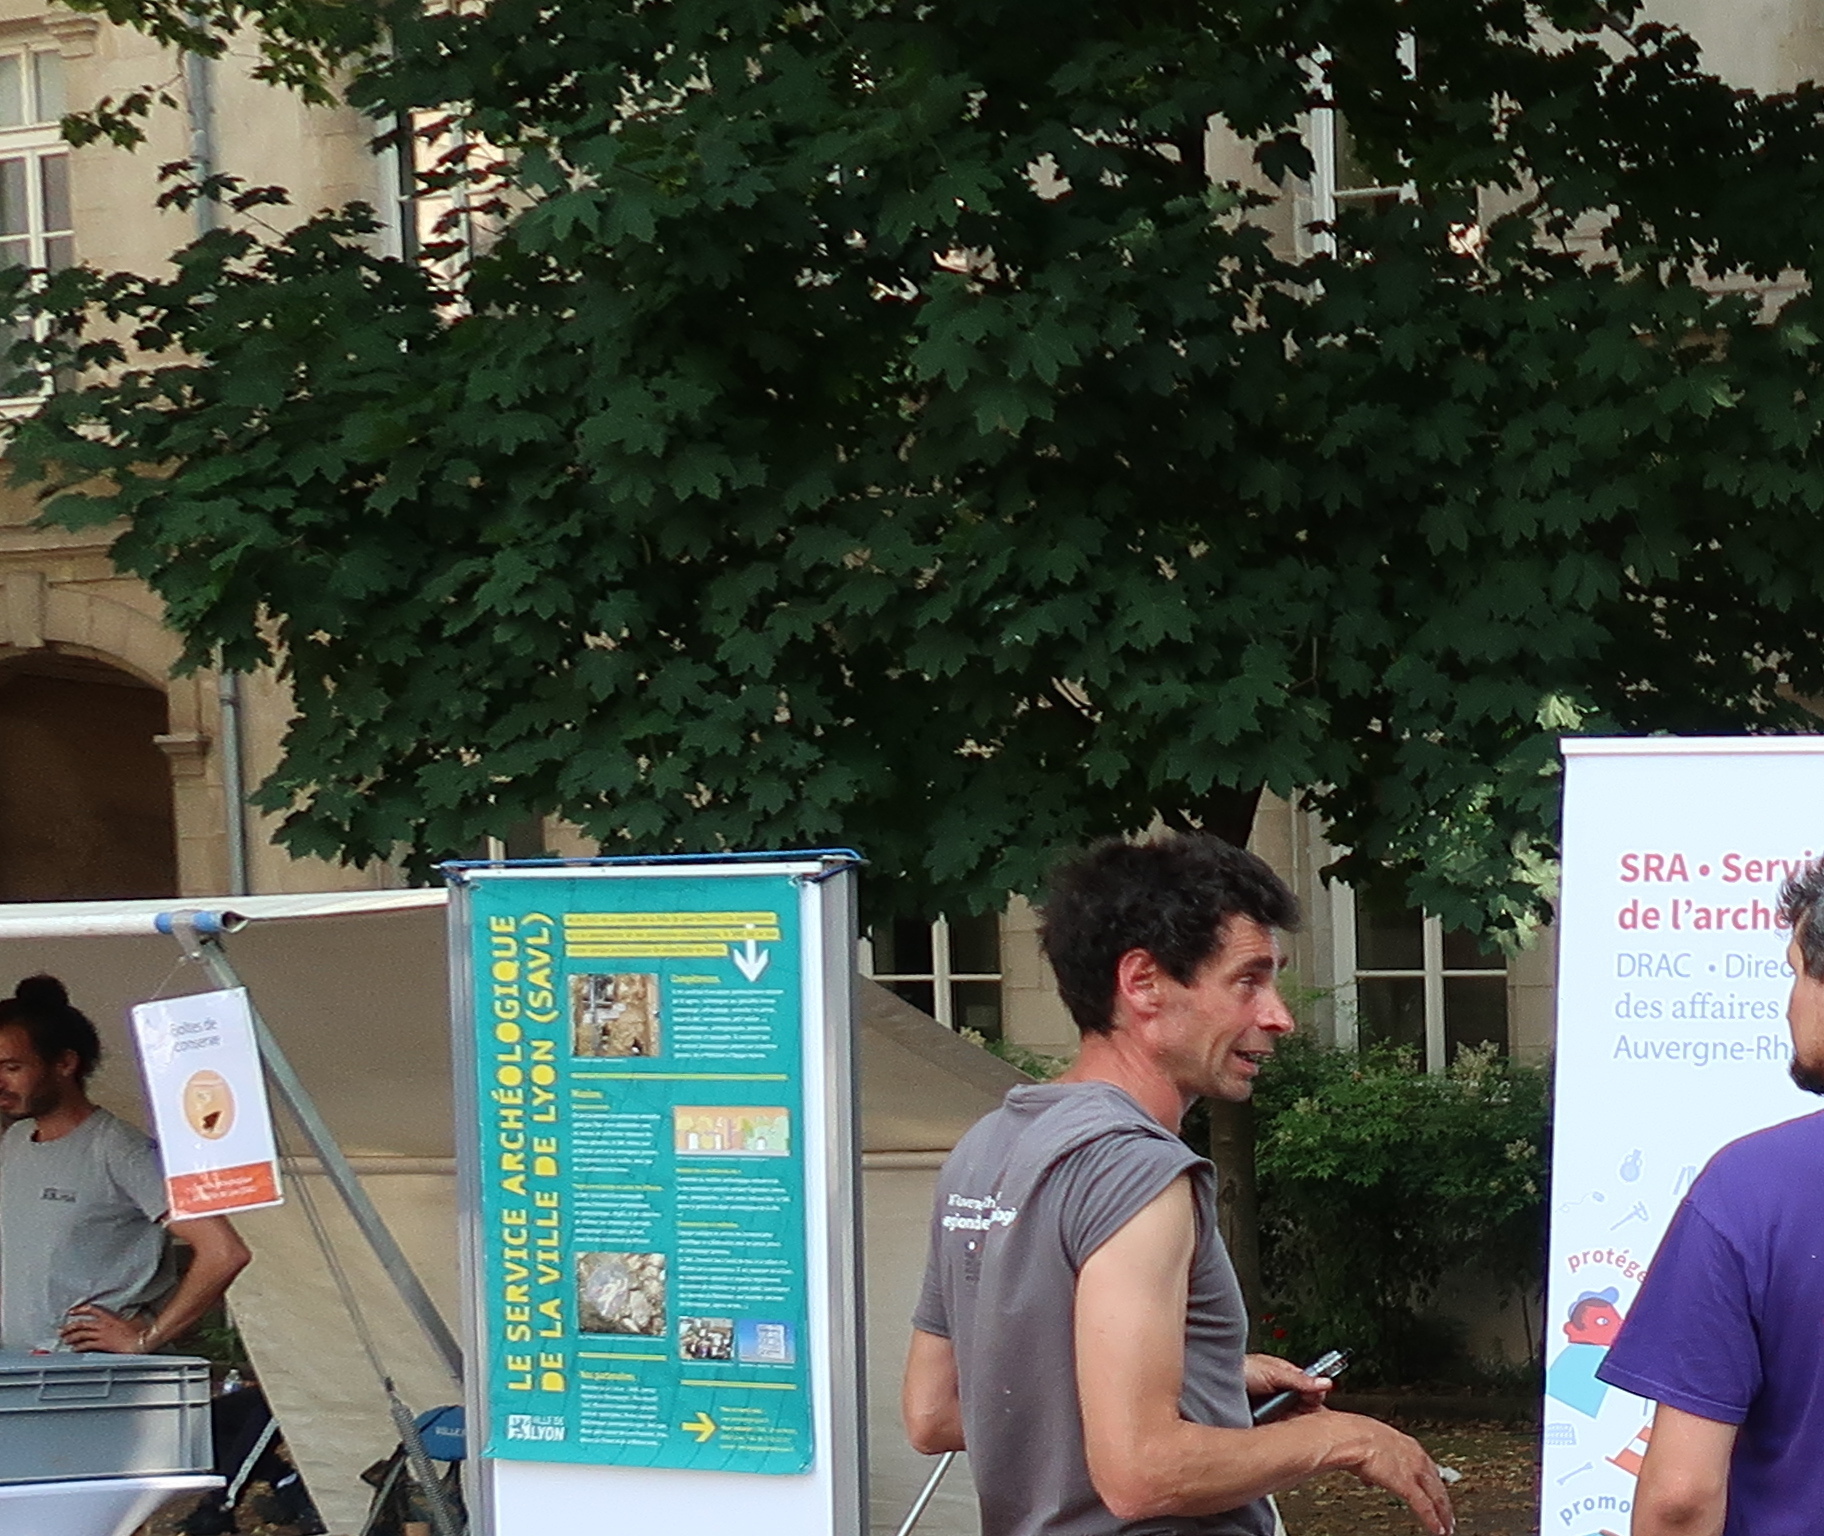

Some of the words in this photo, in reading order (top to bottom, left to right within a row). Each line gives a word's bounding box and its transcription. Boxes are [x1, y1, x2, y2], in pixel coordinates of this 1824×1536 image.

[1620, 853, 1688, 883] SRA
[1721, 850, 1818, 883] Servi
[1618, 900, 1660, 930] de
[522, 912, 557, 1023] (SAVL)
[1616, 953, 1692, 978] DRAC
[1725, 953, 1797, 978] Direc
[1615, 992, 1662, 1019] des
[1671, 991, 1780, 1019] affaires
[491, 915, 528, 1196] ARCHÉOLOGIQUE
[1613, 1034, 1798, 1066] Auvergne-Rh
[531, 1039, 556, 1124] LYON
[533, 1135, 557, 1177] DE
[536, 1190, 560, 1285] VILLE
[503, 1208, 531, 1341] SERVICE
[539, 1302, 562, 1339] LA
[508, 1353, 533, 1390] LE
[540, 1351, 566, 1393] DE
[530, 1426, 565, 1441] LYON
[1559, 1495, 1630, 1526] promo
